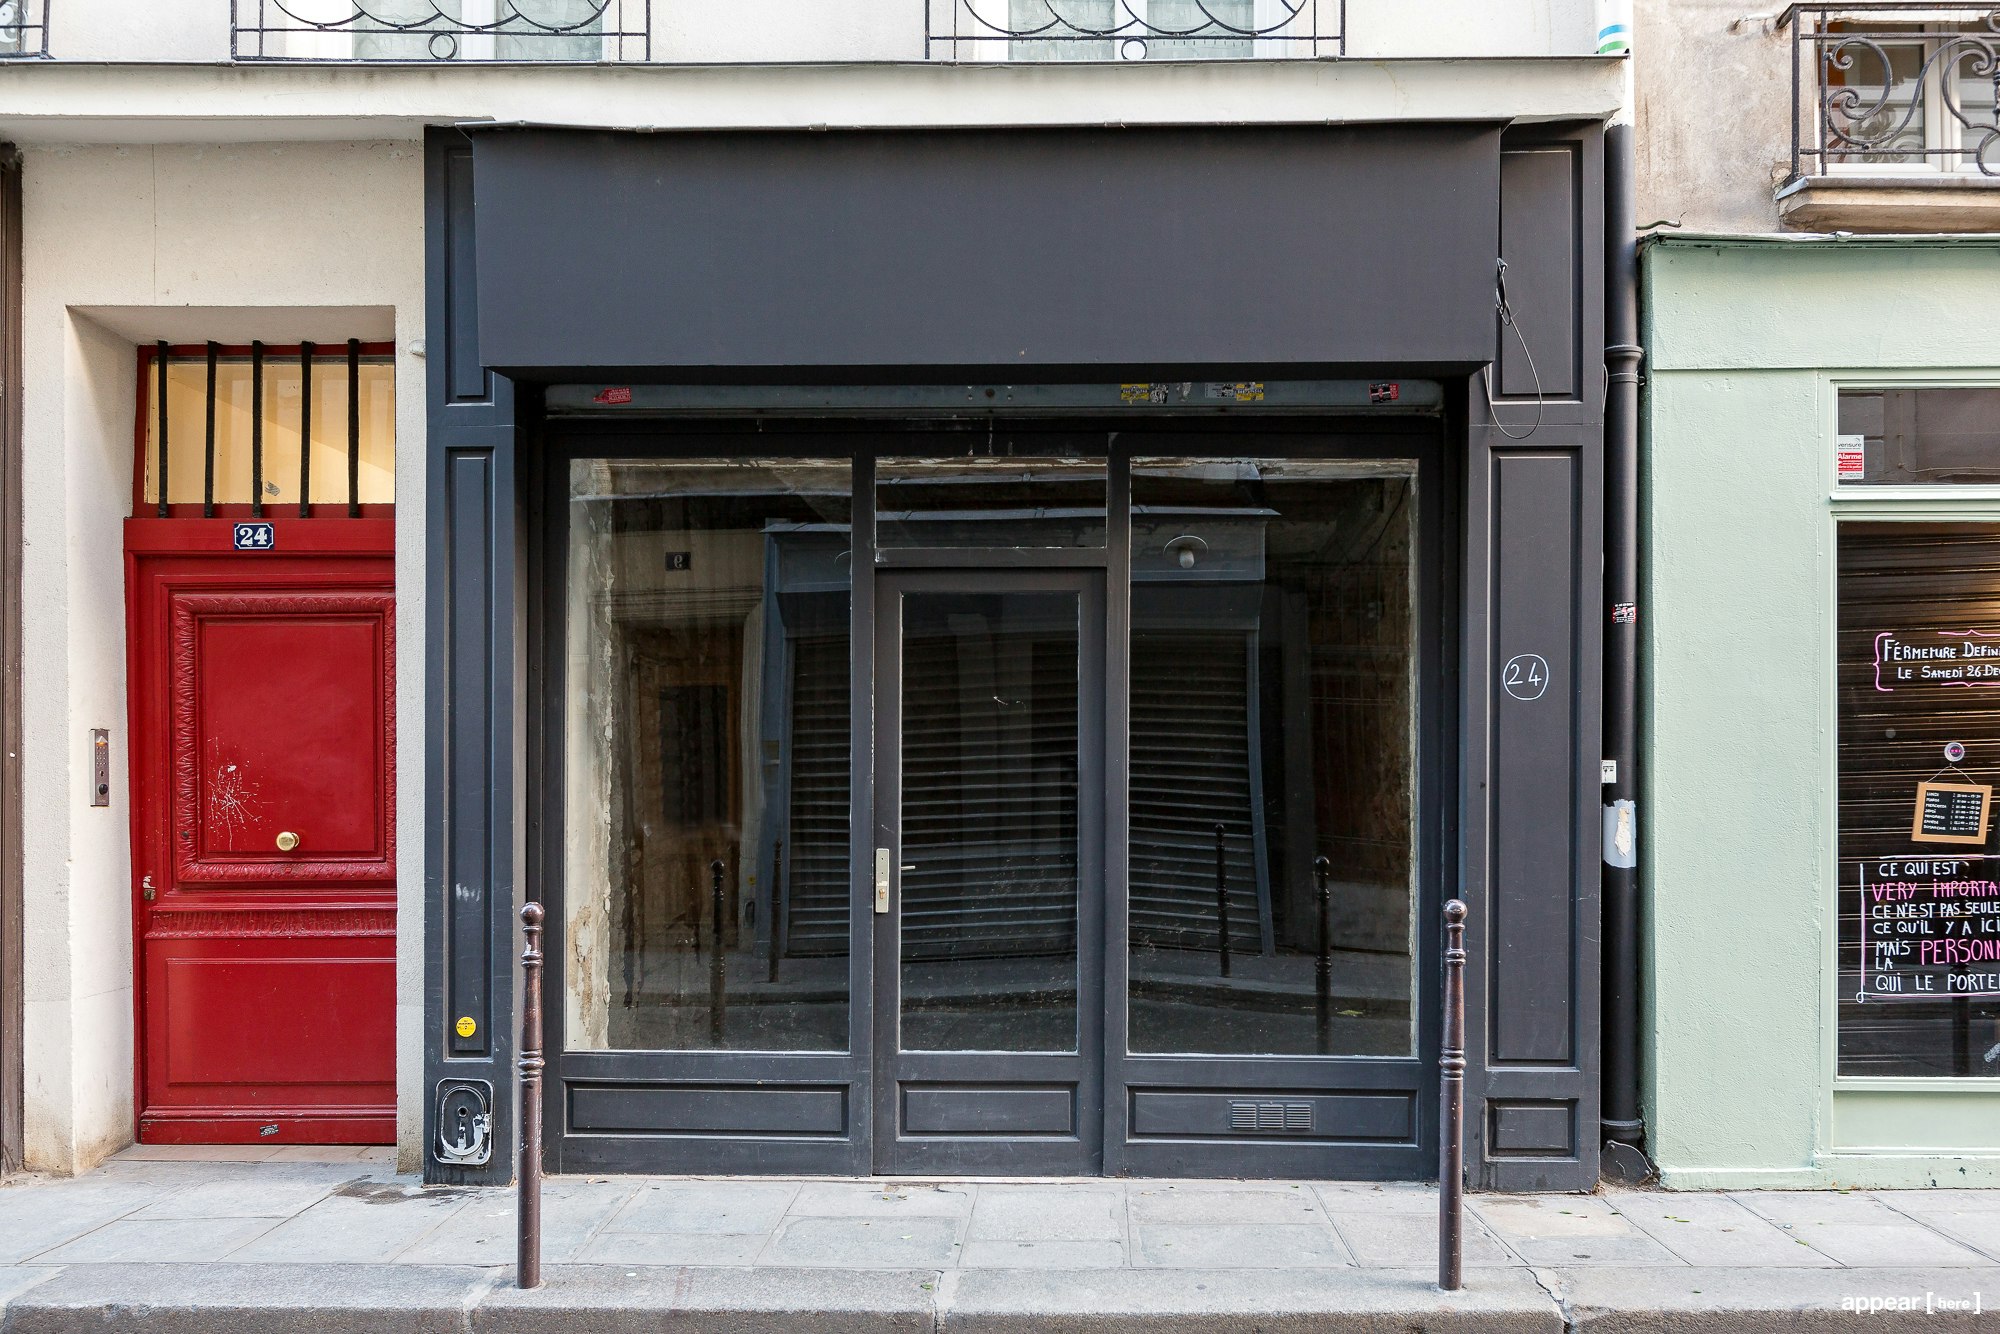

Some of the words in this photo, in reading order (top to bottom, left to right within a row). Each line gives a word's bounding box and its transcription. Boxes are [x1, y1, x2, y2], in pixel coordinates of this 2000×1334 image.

[239, 527, 268, 546] 24
[1507, 662, 1542, 687] 24
[1897, 666, 1912, 679] LE
[1966, 664, 1982, 677] 26
[1983, 664, 2000, 676] DE
[1879, 862, 1898, 876] CE
[1933, 862, 1959, 875] EST
[1872, 881, 1917, 902] VERY
[1933, 878, 2000, 898] iMPORTA
[1872, 905, 1891, 919] CE
[1896, 902, 1936, 918] N'EST
[1940, 903, 1960, 917] PAS
[1965, 901, 2000, 914] SEULE
[1873, 922, 1892, 934] CE
[1945, 921, 1955, 934] Y
[1961, 921, 1972, 935] A
[1876, 957, 1893, 971] LA
[1915, 975, 1933, 991] LE
[1947, 973, 2000, 991] PORTE
